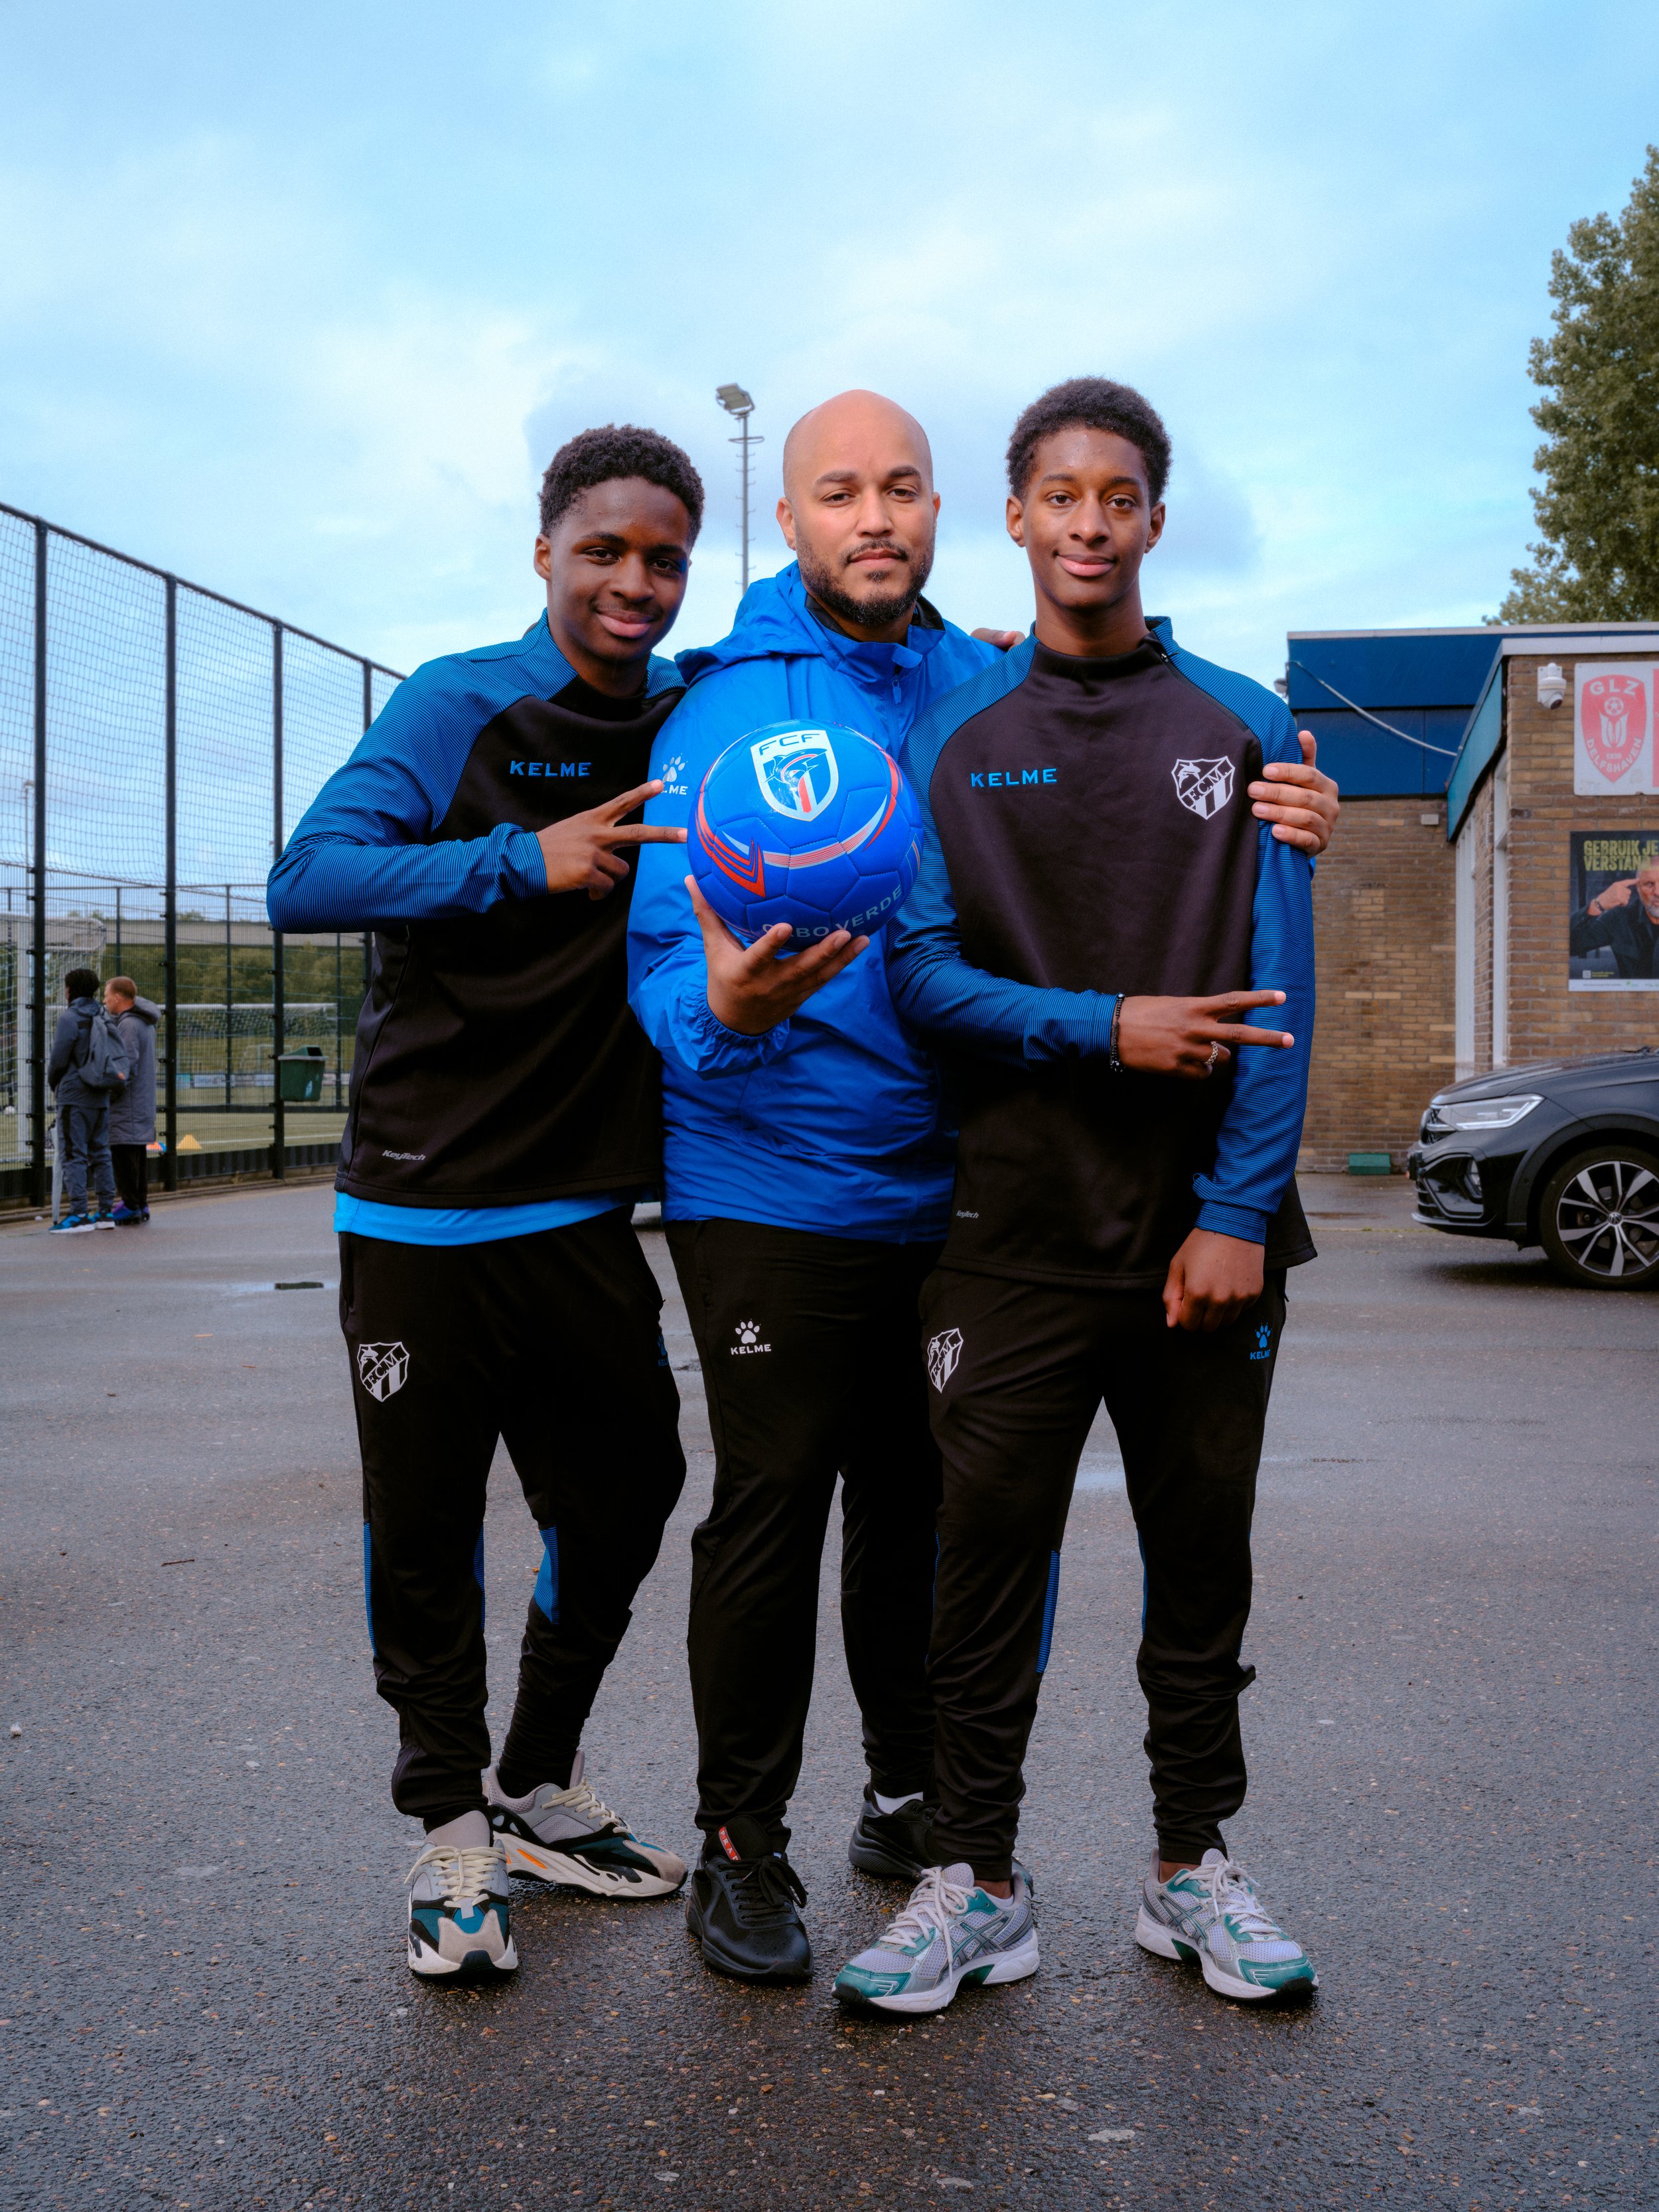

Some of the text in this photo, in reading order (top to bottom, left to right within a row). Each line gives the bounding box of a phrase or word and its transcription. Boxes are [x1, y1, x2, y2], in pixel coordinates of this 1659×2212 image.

[1590, 679, 1639, 696] GLZ
[758, 733, 820, 755] FCF
[1587, 737, 1642, 773] DELFSHAVEN
[510, 761, 591, 777] KELME
[970, 768, 1057, 788] KELME
[1583, 840, 1659, 855] GEBRUIK JE
[762, 884, 902, 938] CBO VERDE
[382, 1149, 426, 1160] KeyTech
[731, 1344, 772, 1355] KELME
